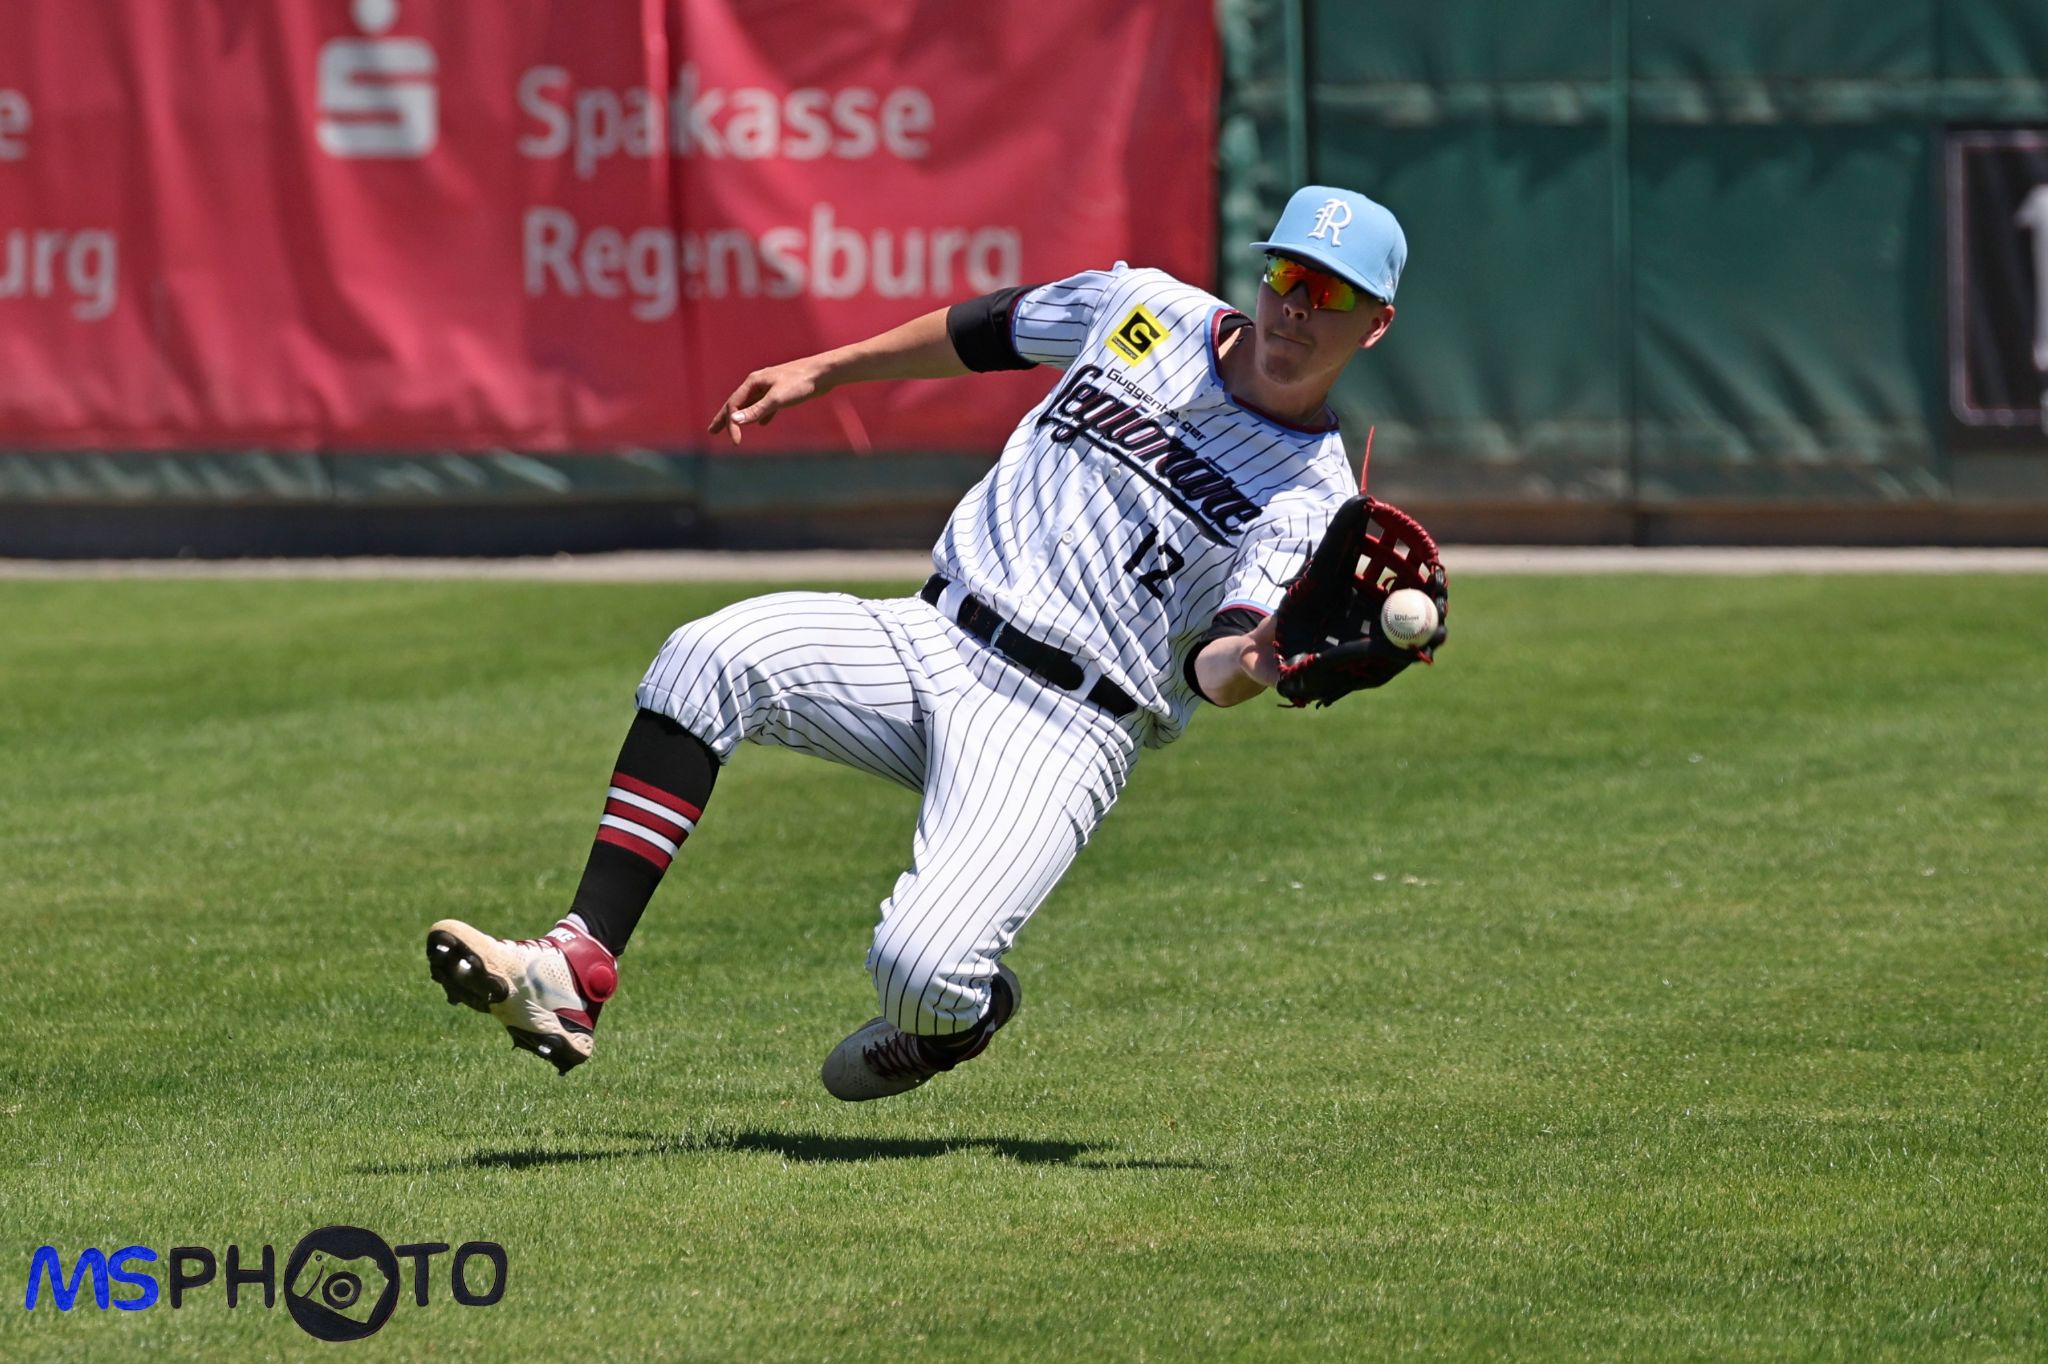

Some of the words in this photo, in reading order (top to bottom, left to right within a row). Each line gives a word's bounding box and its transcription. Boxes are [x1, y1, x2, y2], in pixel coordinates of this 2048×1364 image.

[517, 61, 934, 178] Spakasse
[1307, 198, 1352, 247] R
[1122, 522, 1185, 601] 12
